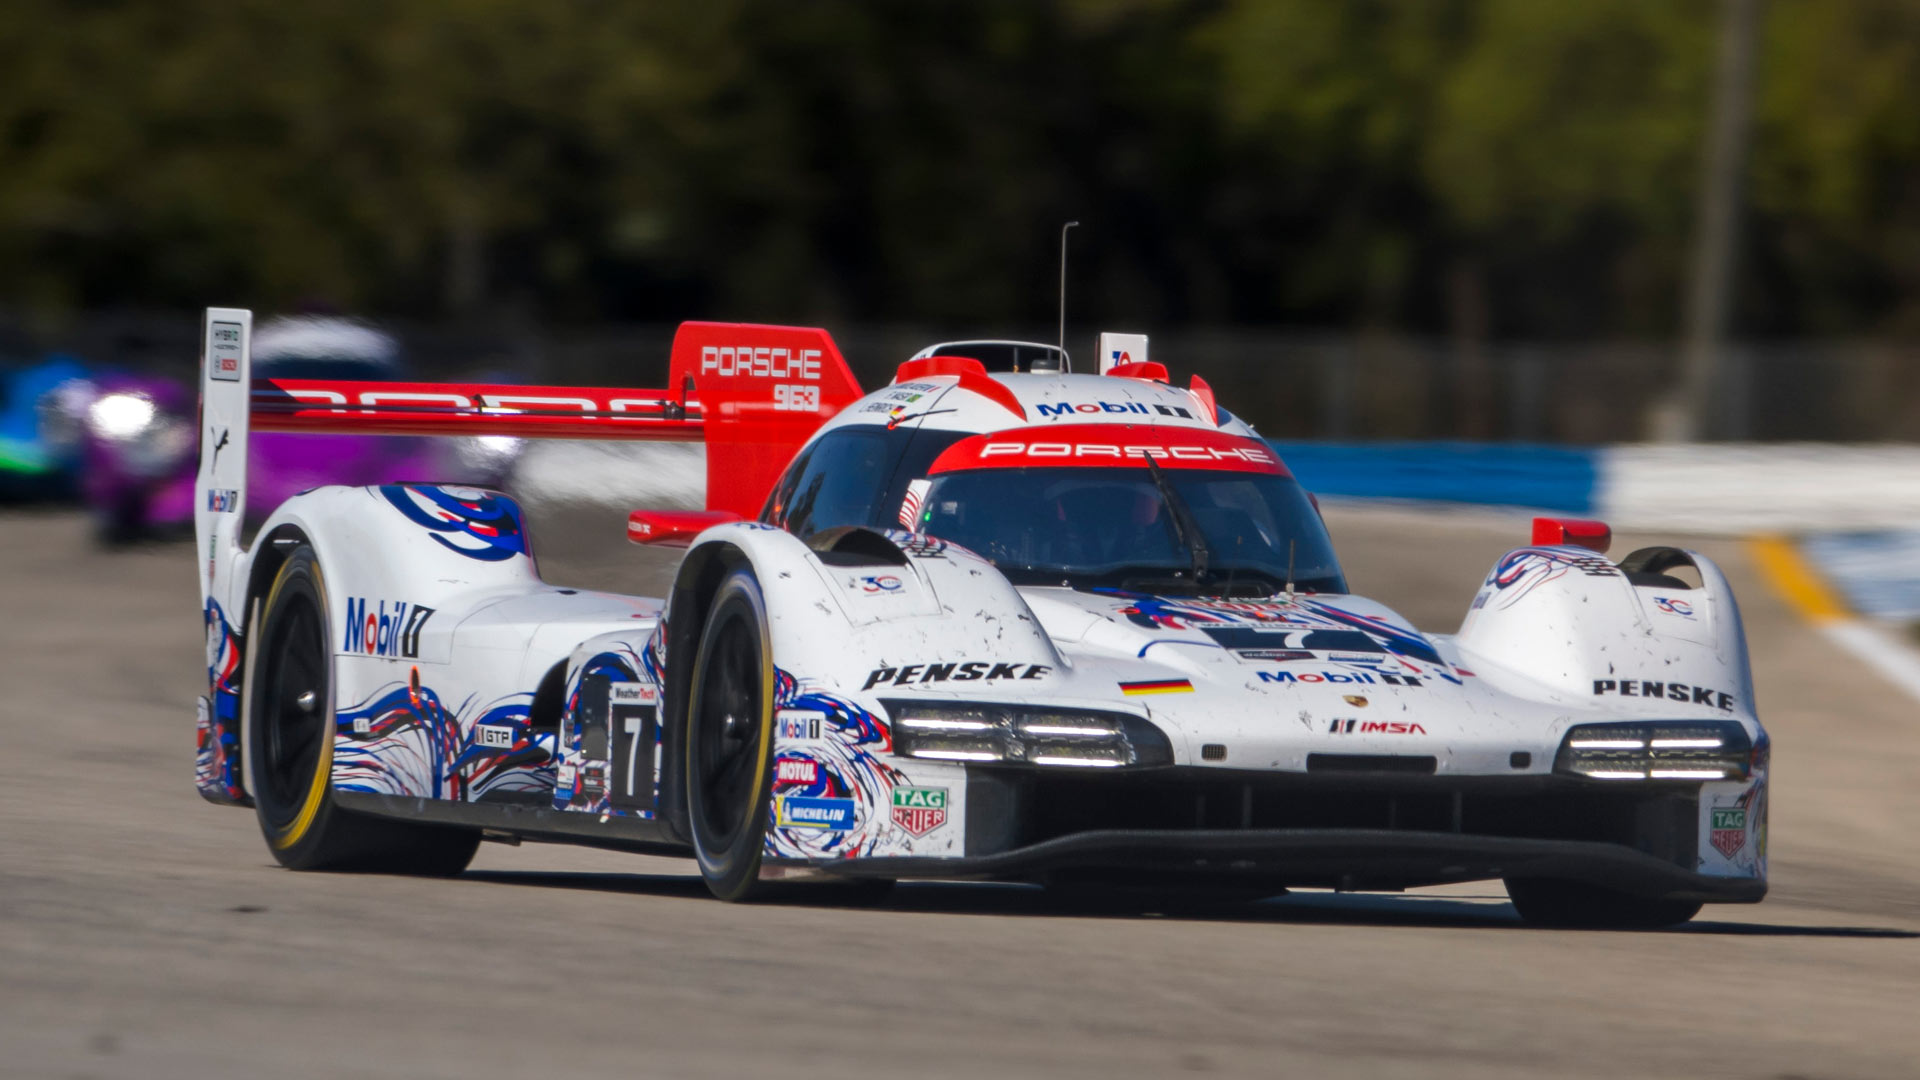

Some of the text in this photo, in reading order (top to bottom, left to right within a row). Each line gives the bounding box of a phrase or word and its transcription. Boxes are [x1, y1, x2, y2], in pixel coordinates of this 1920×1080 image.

[701, 346, 821, 379] PORSCHE
[774, 384, 820, 412] 963
[1036, 401, 1150, 416] Mobil
[980, 443, 1274, 463] PORSCHE
[344, 597, 432, 656] Mobil 1
[1252, 629, 1313, 648] 7
[861, 662, 1052, 691] PENSKE
[1256, 671, 1376, 684] Mobil
[1594, 680, 1734, 712] PENSKE
[487, 730, 509, 743] GTP
[780, 718, 807, 739] Mobil
[1360, 722, 1427, 735] IMSA
[625, 718, 642, 796] 7
[779, 760, 815, 781] MOTUL
[896, 790, 942, 807] TAG
[792, 806, 845, 821] MICHELIN
[893, 810, 943, 833] HEUER
[1715, 813, 1743, 827] TAG
[1713, 830, 1744, 854] HEUER
